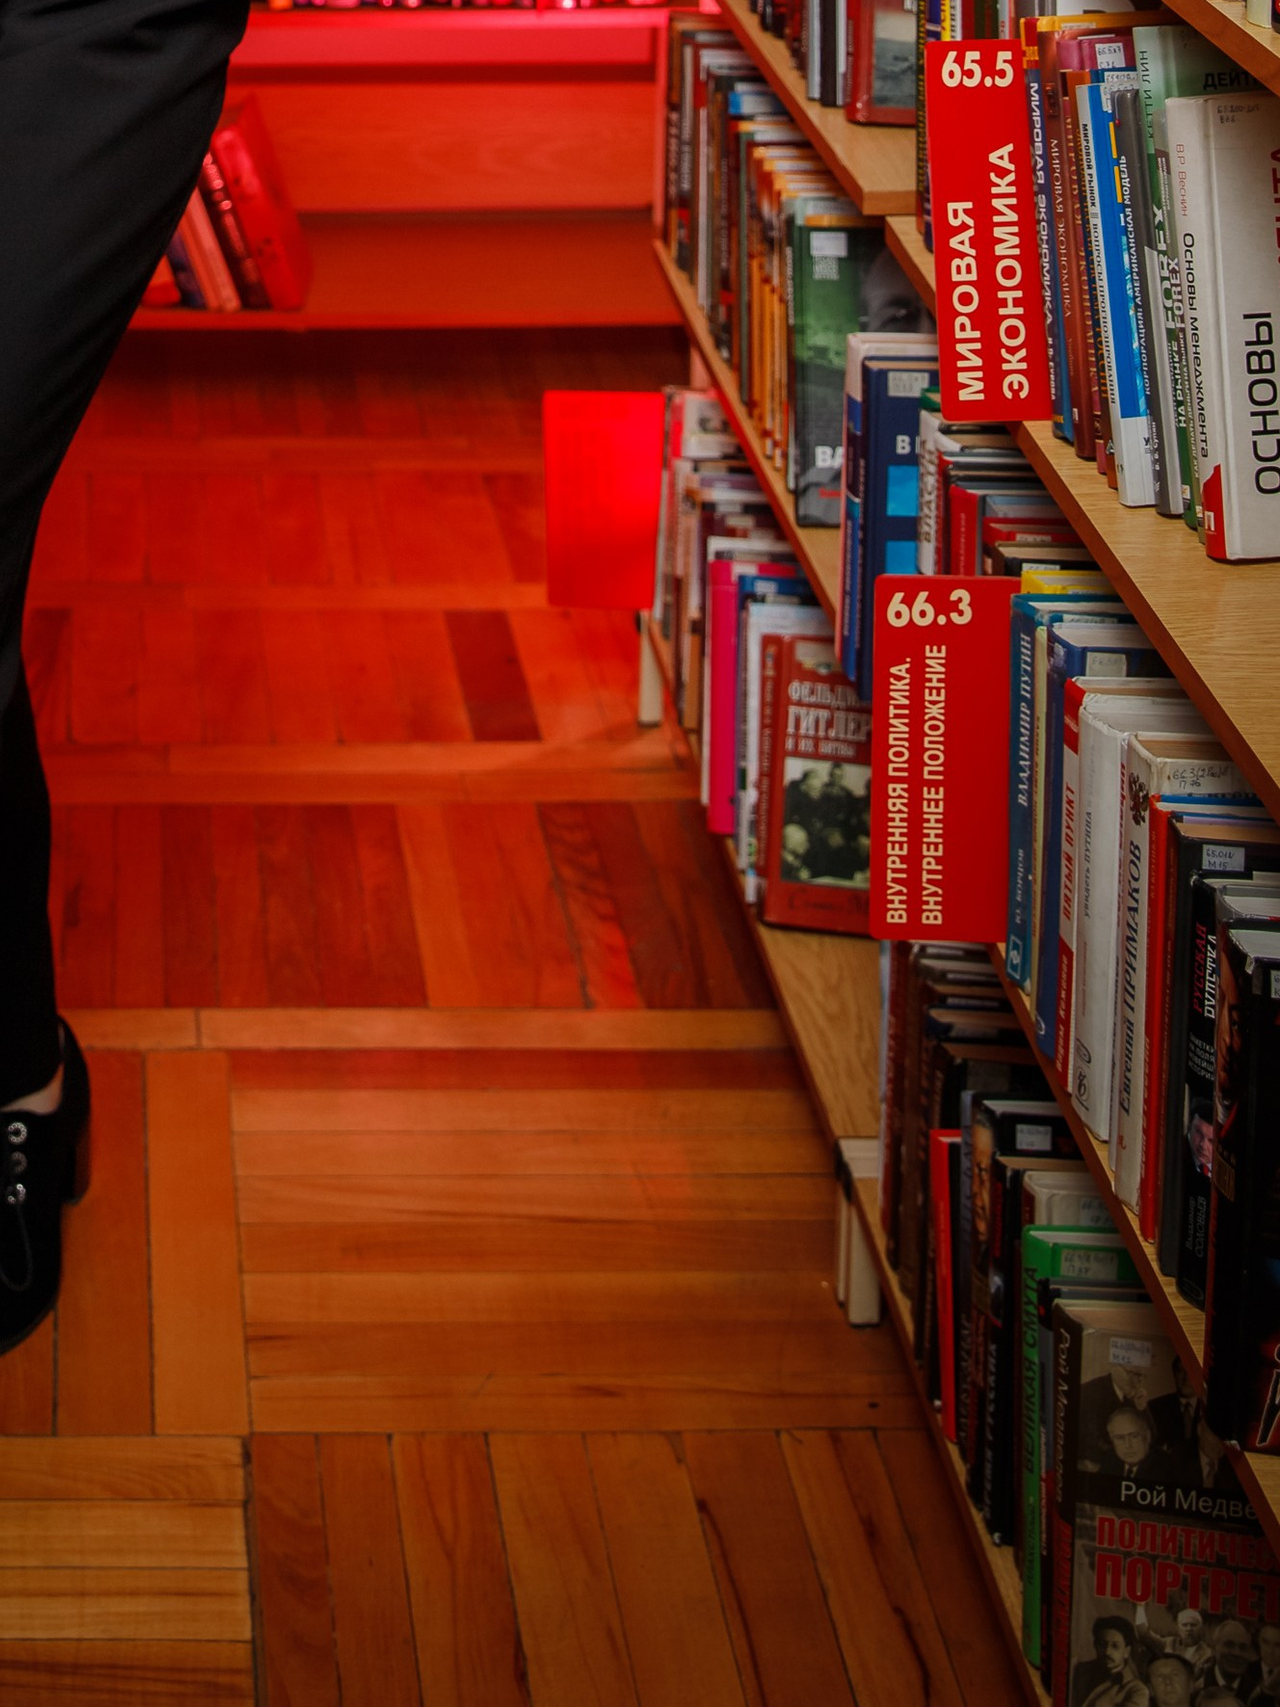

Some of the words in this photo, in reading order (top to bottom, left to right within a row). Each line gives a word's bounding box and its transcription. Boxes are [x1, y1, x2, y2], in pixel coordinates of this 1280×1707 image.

[941, 50, 1014, 88] 65.5
[1139, 49, 1152, 84] ЛИН
[1030, 82, 1045, 183] МИРОВАЯ
[1081, 123, 1094, 171] МИРОВОЙ
[1143, 88, 1156, 139] КЕТТИ
[1049, 138, 1064, 213] МИРОВАЯ
[1087, 173, 1097, 208] РЫНОК
[1118, 154, 1132, 204] МОДЕЛЬ
[988, 142, 1030, 400] ЭКОНОМИКА
[1037, 194, 1054, 325] ЭКОНОМИКА
[1056, 217, 1072, 318] ЭКОНОМИКА
[1092, 223, 1104, 276] ВОПРОСЫ
[1124, 207, 1144, 305] АМЕРИКАНСКАЯ
[946, 201, 985, 401] МИРОВАЯ
[1167, 257, 1185, 330] FOREX
[1135, 307, 1152, 395] КОРПОРАЦИЯ:
[1170, 340, 1184, 402] РЫНКЕ
[1177, 406, 1187, 428] НА
[1241, 311, 1280, 495] ОСНОВЫ
[886, 588, 973, 628] 66.3
[1019, 632, 1033, 695] ПУТИН
[887, 657, 911, 777] ПОЛИТИКА.
[923, 644, 947, 780] ПОЛОЖЕНИЕ
[1016, 702, 1032, 807] ВЛАДИМИР
[886, 783, 909, 924] ВНУТРЕННЯЯ
[921, 786, 945, 925] ВНУТРЕННЕЕ
[1015, 848, 1025, 902] БОРЦОВ
[1082, 810, 1094, 865] ПУТИНА
[1083, 867, 1093, 919] увидеть
[1121, 839, 1144, 1014] ПРИМАКОВ
[1192, 922, 1206, 1013] РУССКАЯ
[1118, 1019, 1136, 1116] Евгений
[1024, 1266, 1038, 1349] СМУТА
[1023, 1354, 1037, 1475] ВЕЛИКАЯ
[1120, 1480, 1166, 1507] Рой
[1175, 1488, 1258, 1519] Медве
